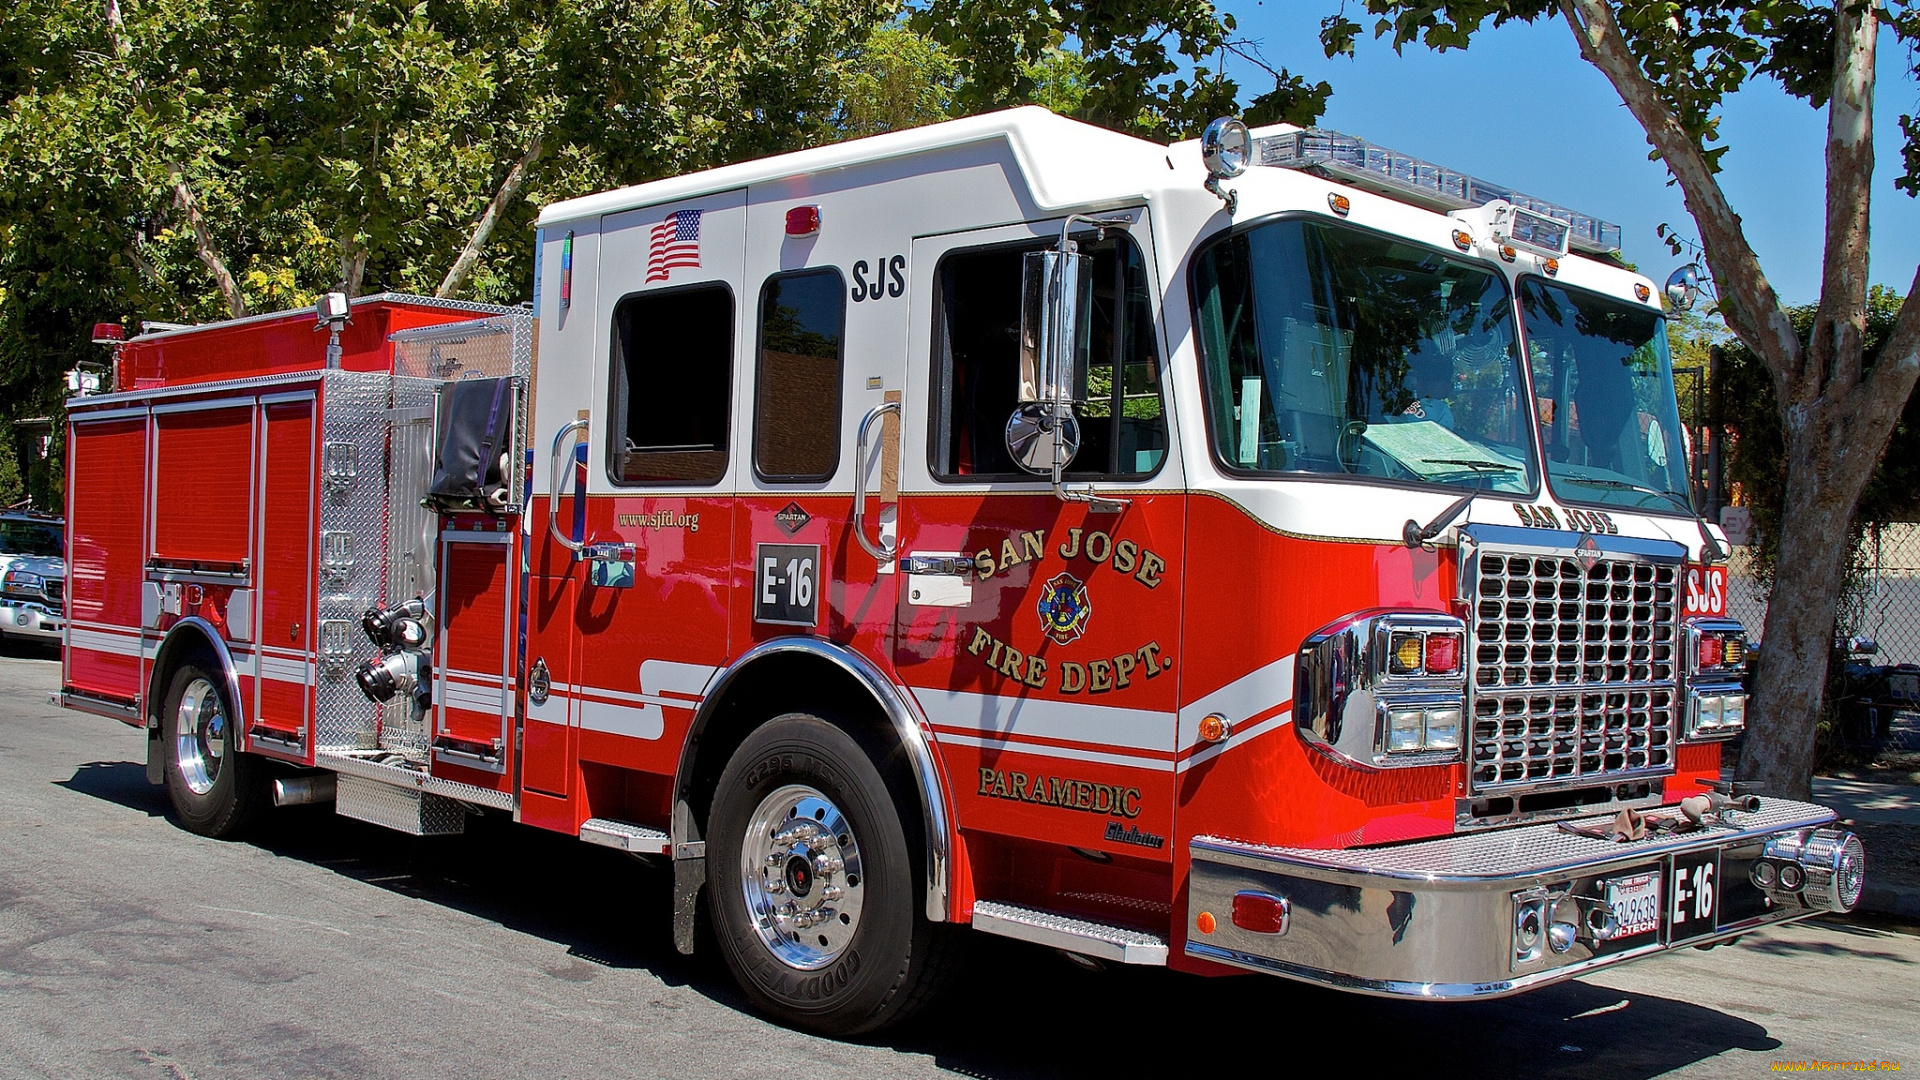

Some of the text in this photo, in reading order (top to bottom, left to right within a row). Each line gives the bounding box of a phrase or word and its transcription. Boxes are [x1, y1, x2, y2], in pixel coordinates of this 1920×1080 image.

[852, 255, 905, 302] SJS
[619, 510, 699, 532] www.sjfd.org
[777, 513, 806, 521] SPARTAN
[1513, 503, 1618, 534] SAN JOSE
[974, 528, 1165, 588] SAN JOSE
[1577, 548, 1601, 558] SPARTAN
[762, 557, 812, 607] E-16
[1687, 568, 1722, 613] SJS
[967, 625, 1173, 694] FIRE DEPT.
[977, 767, 1141, 819] PARAMEDIC
[1104, 821, 1164, 849] Gladiator
[1612, 894, 1656, 926] 349638
[1673, 862, 1714, 924] E-16
[738, 927, 861, 999] GOODYEAR
